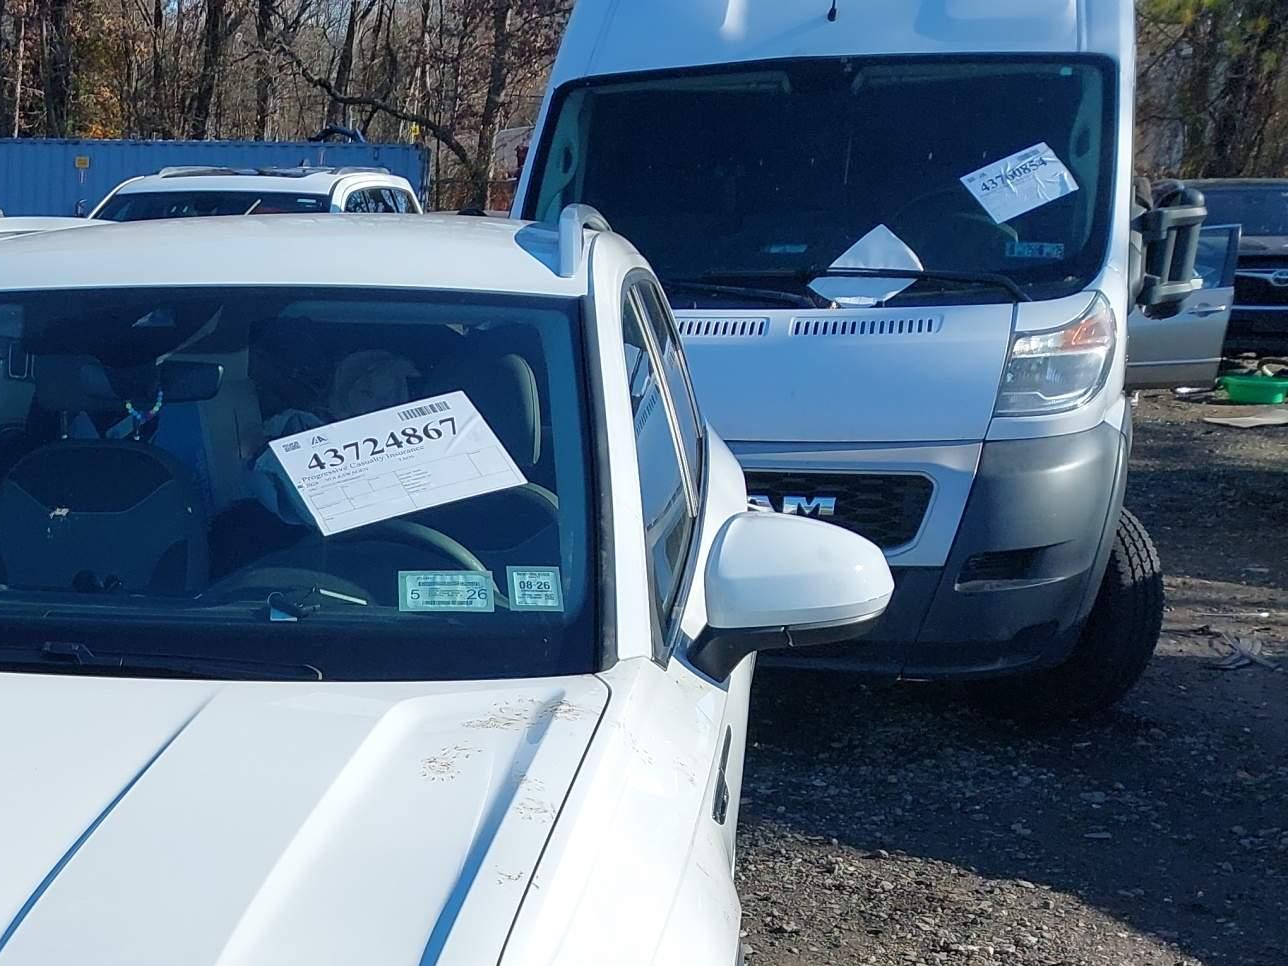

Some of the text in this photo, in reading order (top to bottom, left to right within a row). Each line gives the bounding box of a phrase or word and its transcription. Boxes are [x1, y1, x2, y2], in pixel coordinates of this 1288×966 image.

[307, 417, 457, 470] 43724867
[301, 464, 349, 483] Progressive
[349, 455, 385, 469] Casualty
[385, 445, 425, 460] Insurance
[747, 494, 837, 515] AM
[410, 588, 421, 600] 5
[466, 588, 488, 601] 26
